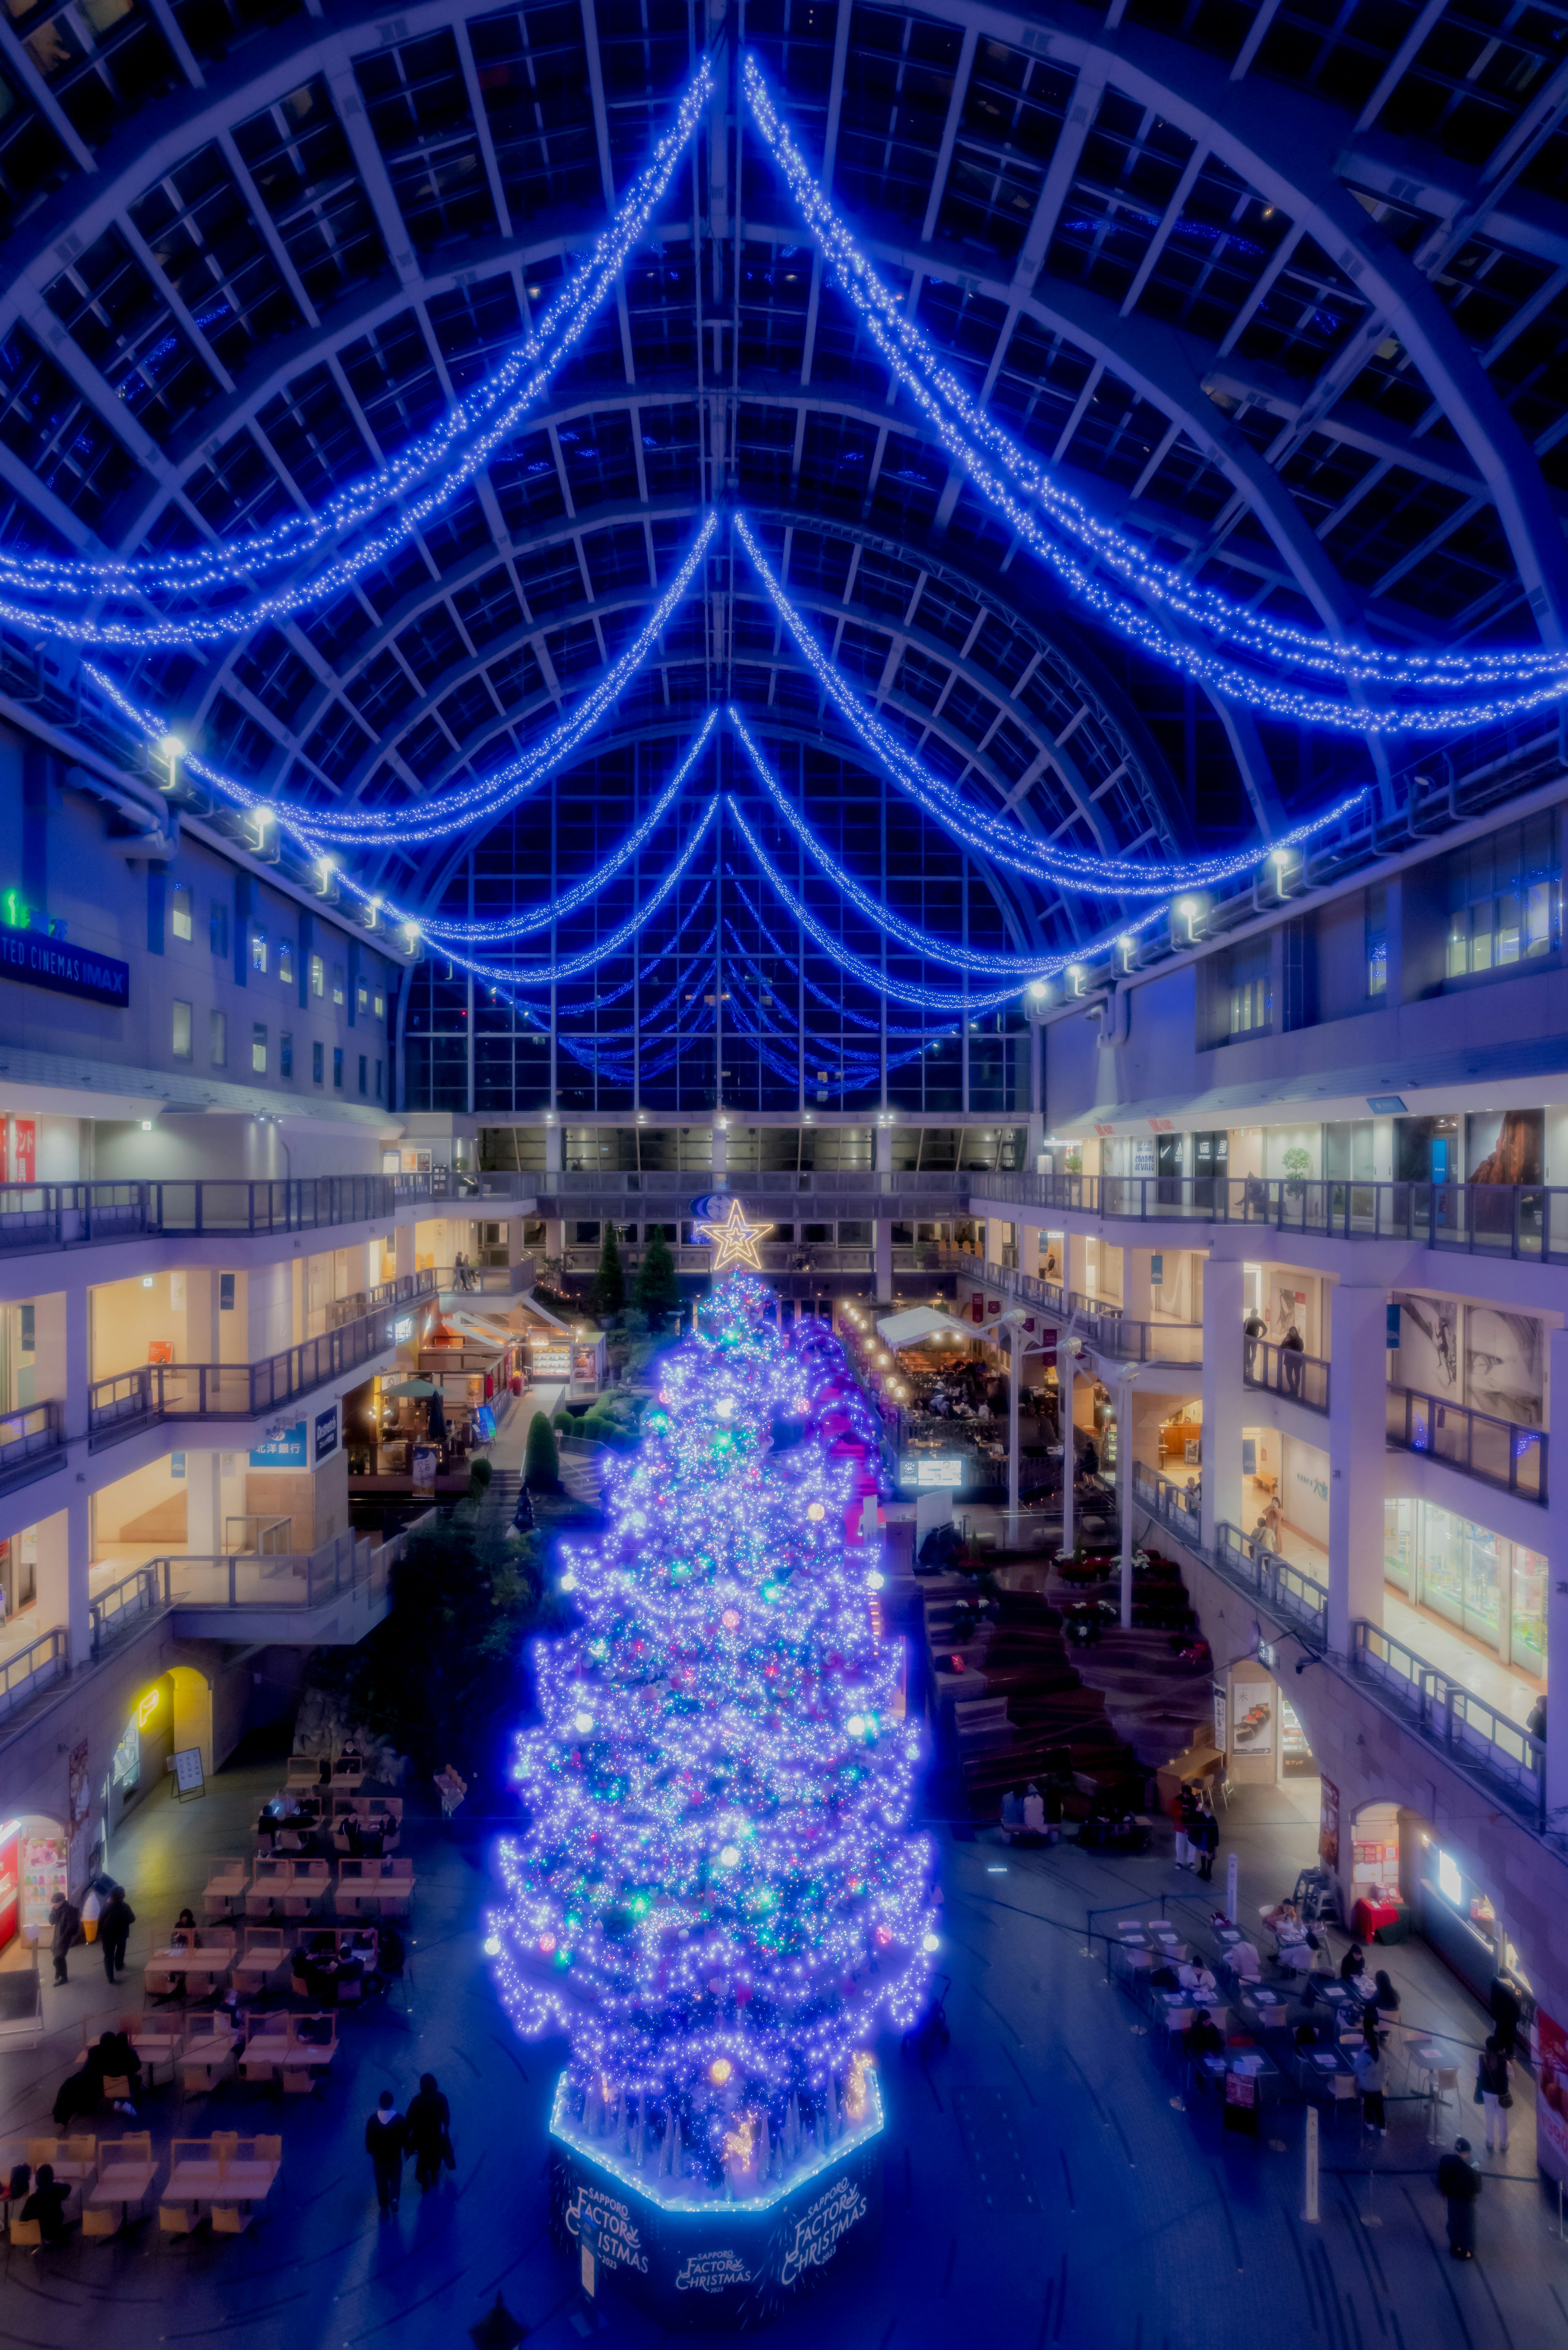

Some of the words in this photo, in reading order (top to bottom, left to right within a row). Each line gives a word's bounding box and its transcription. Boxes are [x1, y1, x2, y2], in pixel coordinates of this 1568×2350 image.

[31, 946, 79, 981] CINEMAS
[82, 963, 123, 993] IMAX
[1200, 1142, 1209, 1153] VANS
[1135, 1155, 1154, 1171] SPORTS
[256, 1443, 301, 1454] 北洋銀行
[1238, 1691, 1248, 1702] 米
[589, 2187, 630, 2221] SAPPORO
[807, 2177, 849, 2219] SAPPORO
[571, 2186, 641, 2248] FACTORY
[787, 2183, 860, 2263] FACTORY
[566, 2200, 648, 2274] CISTMAS
[782, 2197, 866, 2285] CHRISTMAS
[602, 2256, 617, 2269] 2023
[698, 2250, 735, 2260] SAPPORO
[822, 2245, 836, 2265] 2023
[681, 2257, 744, 2279] FACTORY
[676, 2270, 751, 2292] CHRISTMAS
